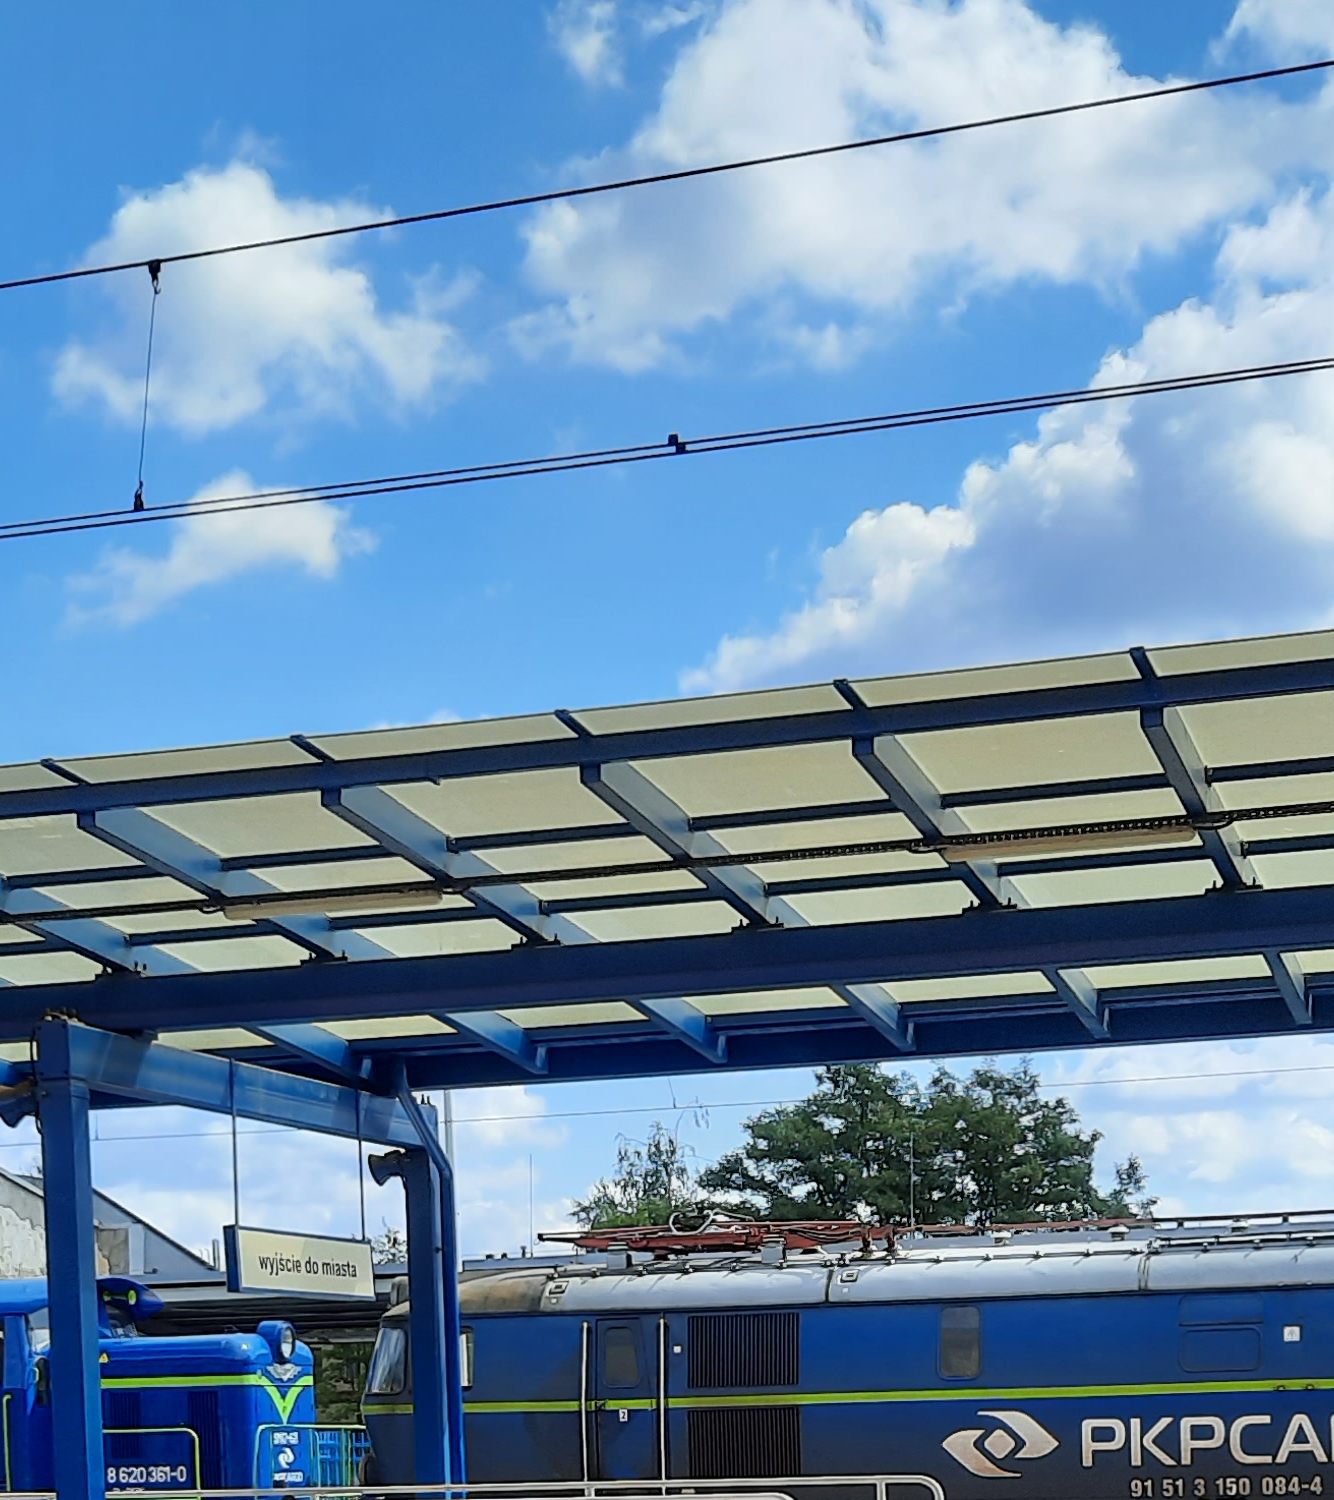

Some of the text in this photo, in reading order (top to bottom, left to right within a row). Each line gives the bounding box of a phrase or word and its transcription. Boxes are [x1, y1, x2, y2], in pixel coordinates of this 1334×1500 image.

[259, 1251, 357, 1277] wyjście do miasta
[119, 1467, 146, 1483] 620
[148, 1466, 187, 1482] 361-0
[1131, 1476, 1323, 1497] 91 51 3 150 084-4
